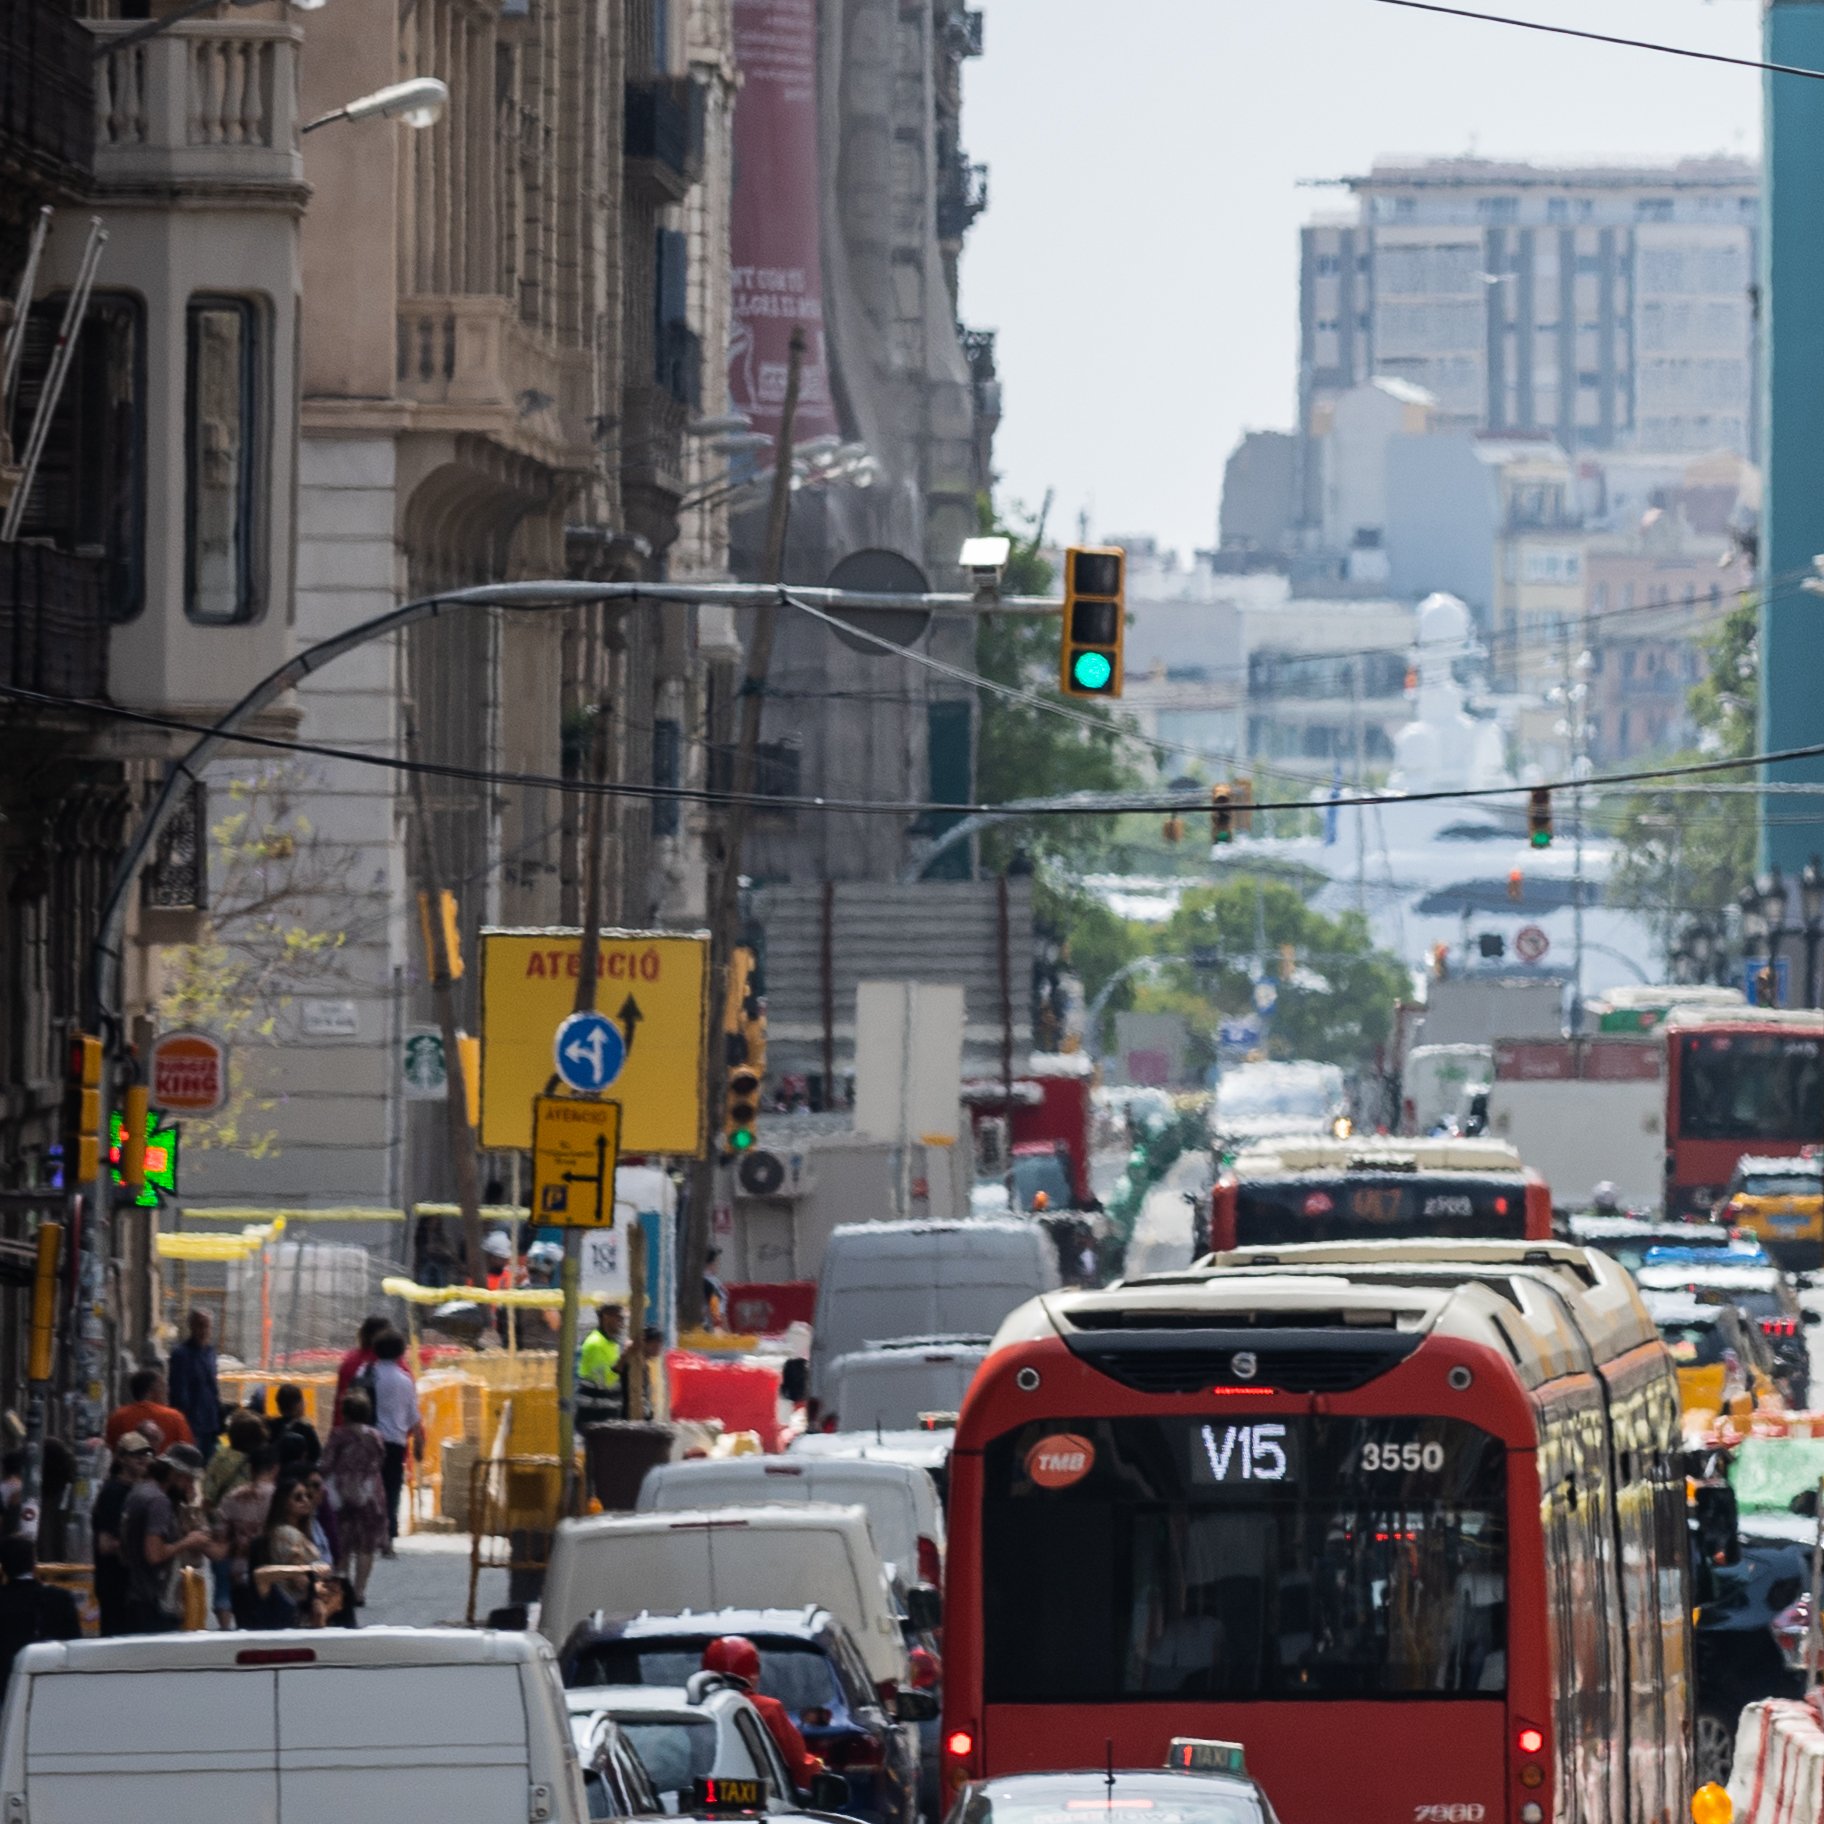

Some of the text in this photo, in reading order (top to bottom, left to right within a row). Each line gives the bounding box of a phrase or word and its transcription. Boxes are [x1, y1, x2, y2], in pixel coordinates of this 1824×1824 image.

[156, 1077, 218, 1095] KING
[1037, 1453, 1086, 1474] TMB
[1202, 1423, 1288, 1481] V15
[1361, 1443, 1445, 1472] 3550
[719, 1780, 758, 1803] TAXI
